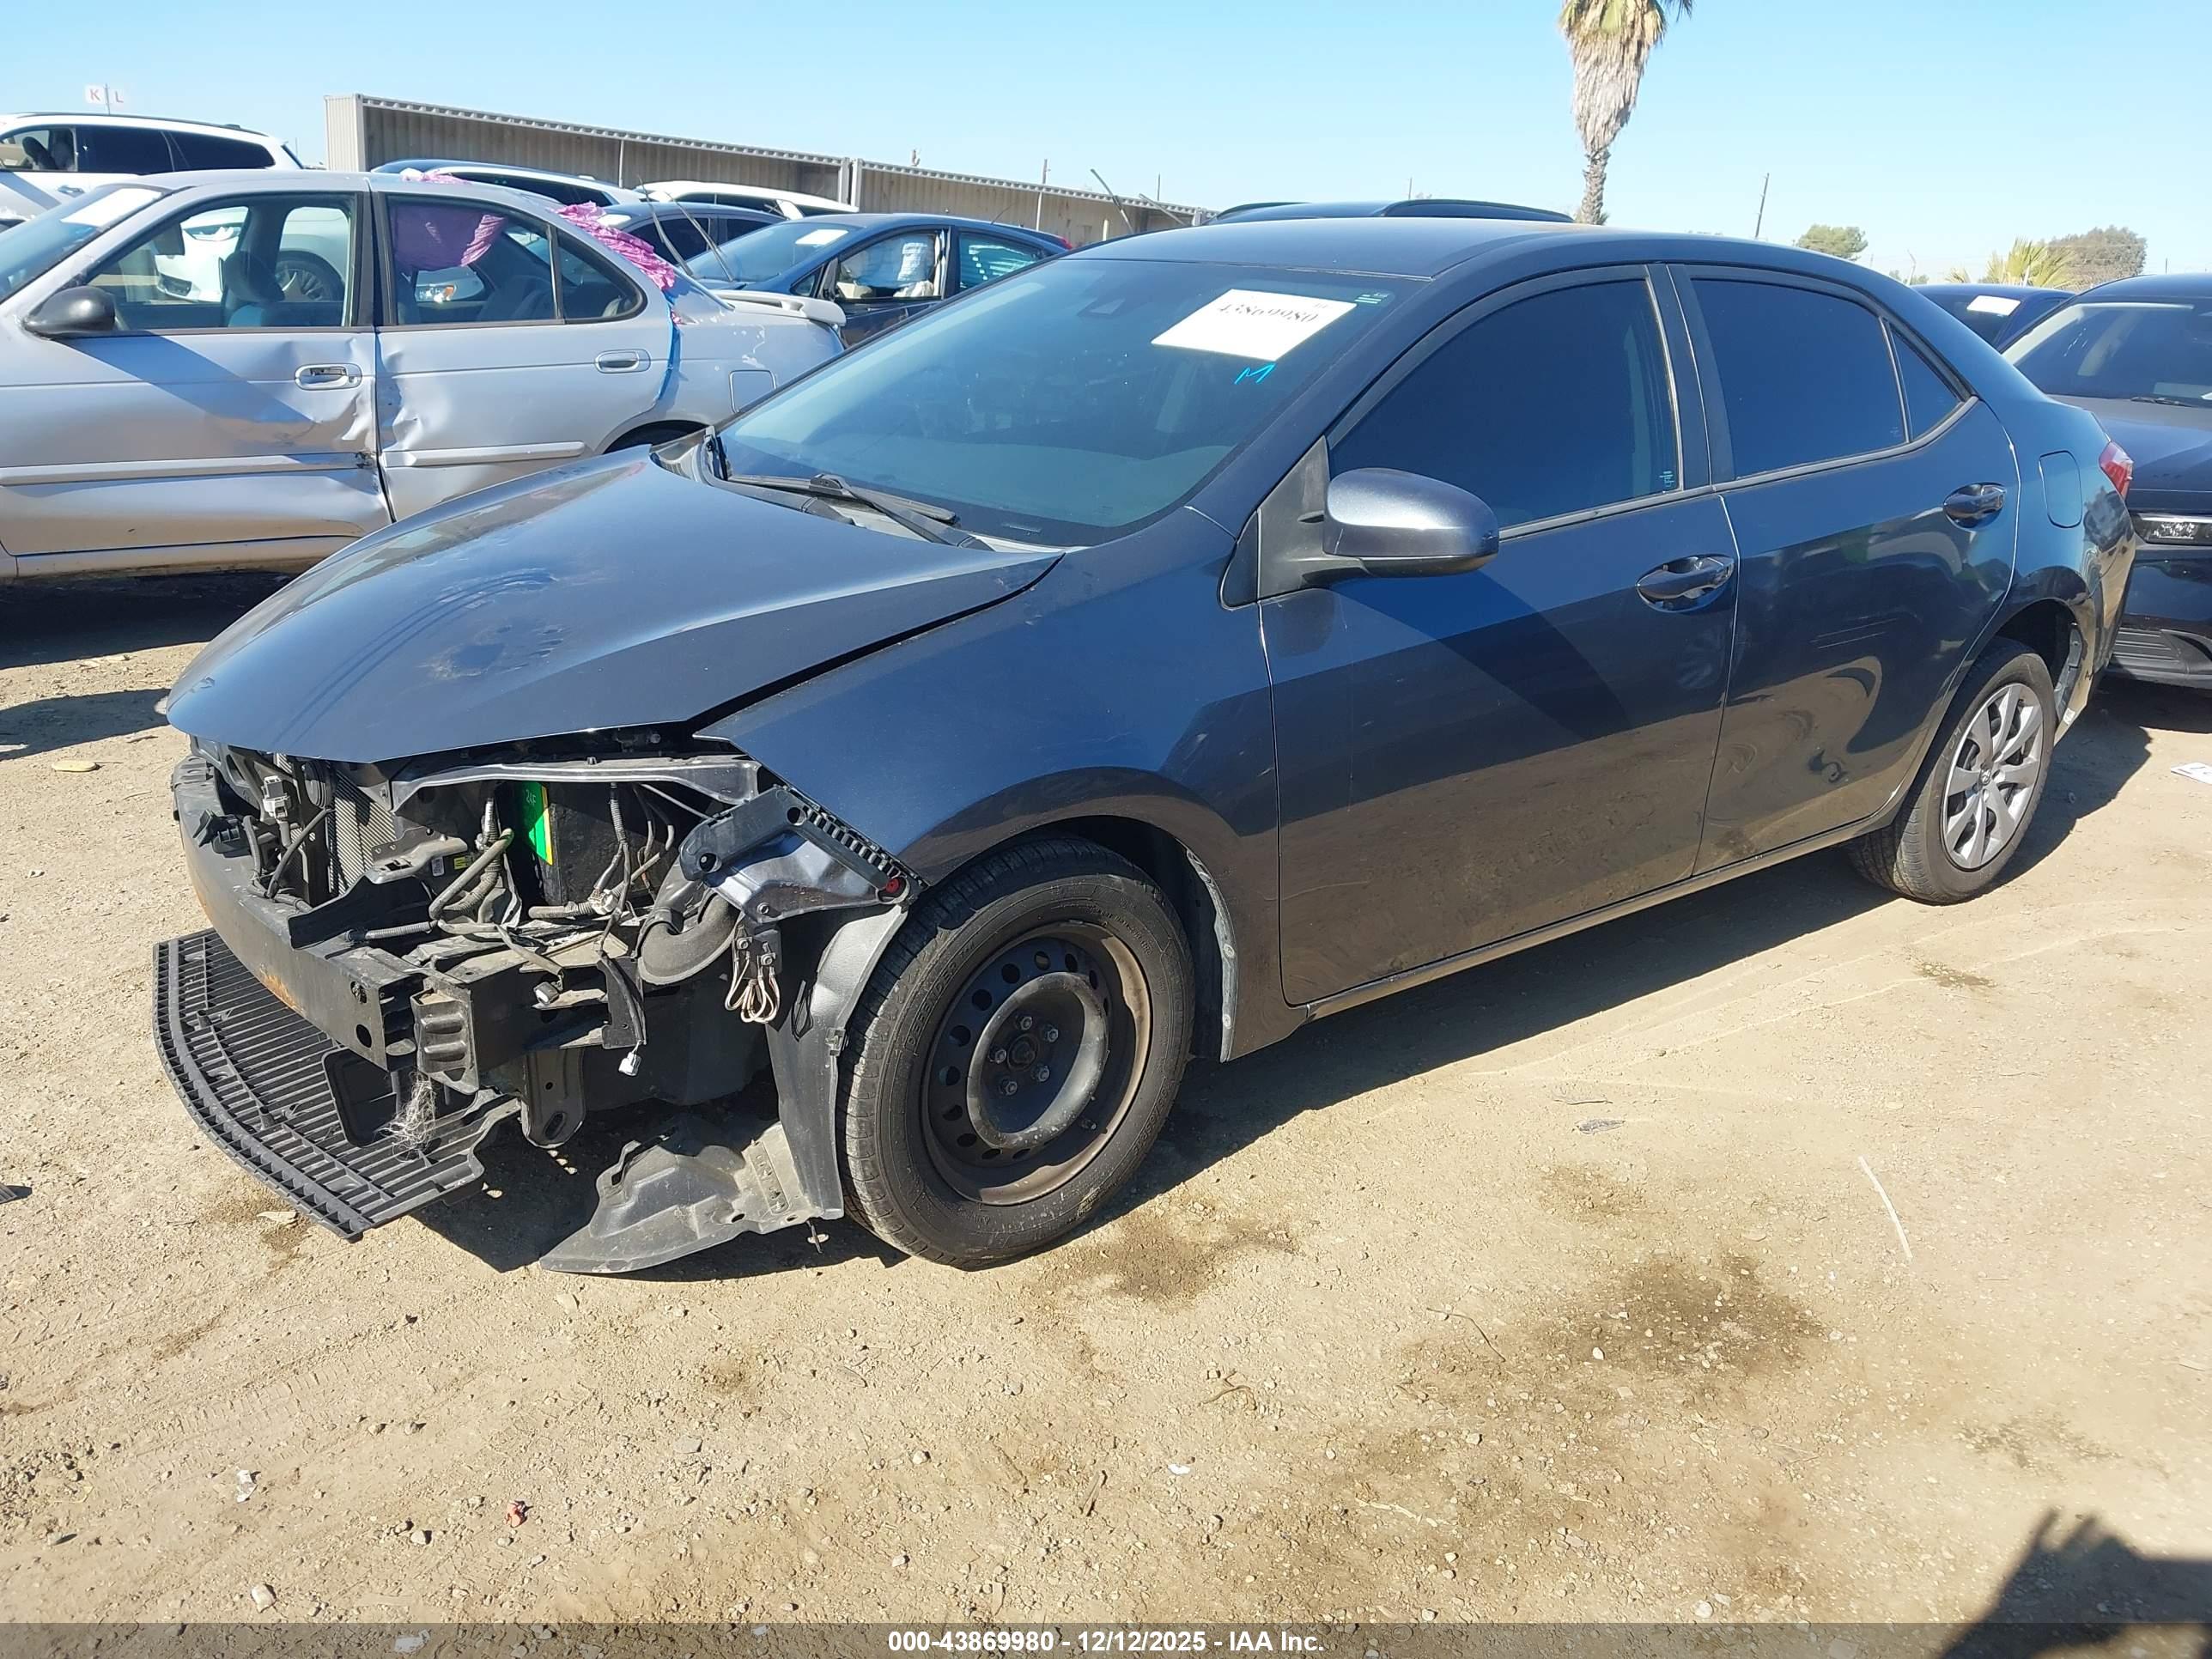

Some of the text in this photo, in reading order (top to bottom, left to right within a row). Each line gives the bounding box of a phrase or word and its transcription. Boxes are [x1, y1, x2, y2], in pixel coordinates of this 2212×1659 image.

[89, 88, 101, 102] K
[114, 90, 125, 103] L
[1233, 362, 1278, 385] M
